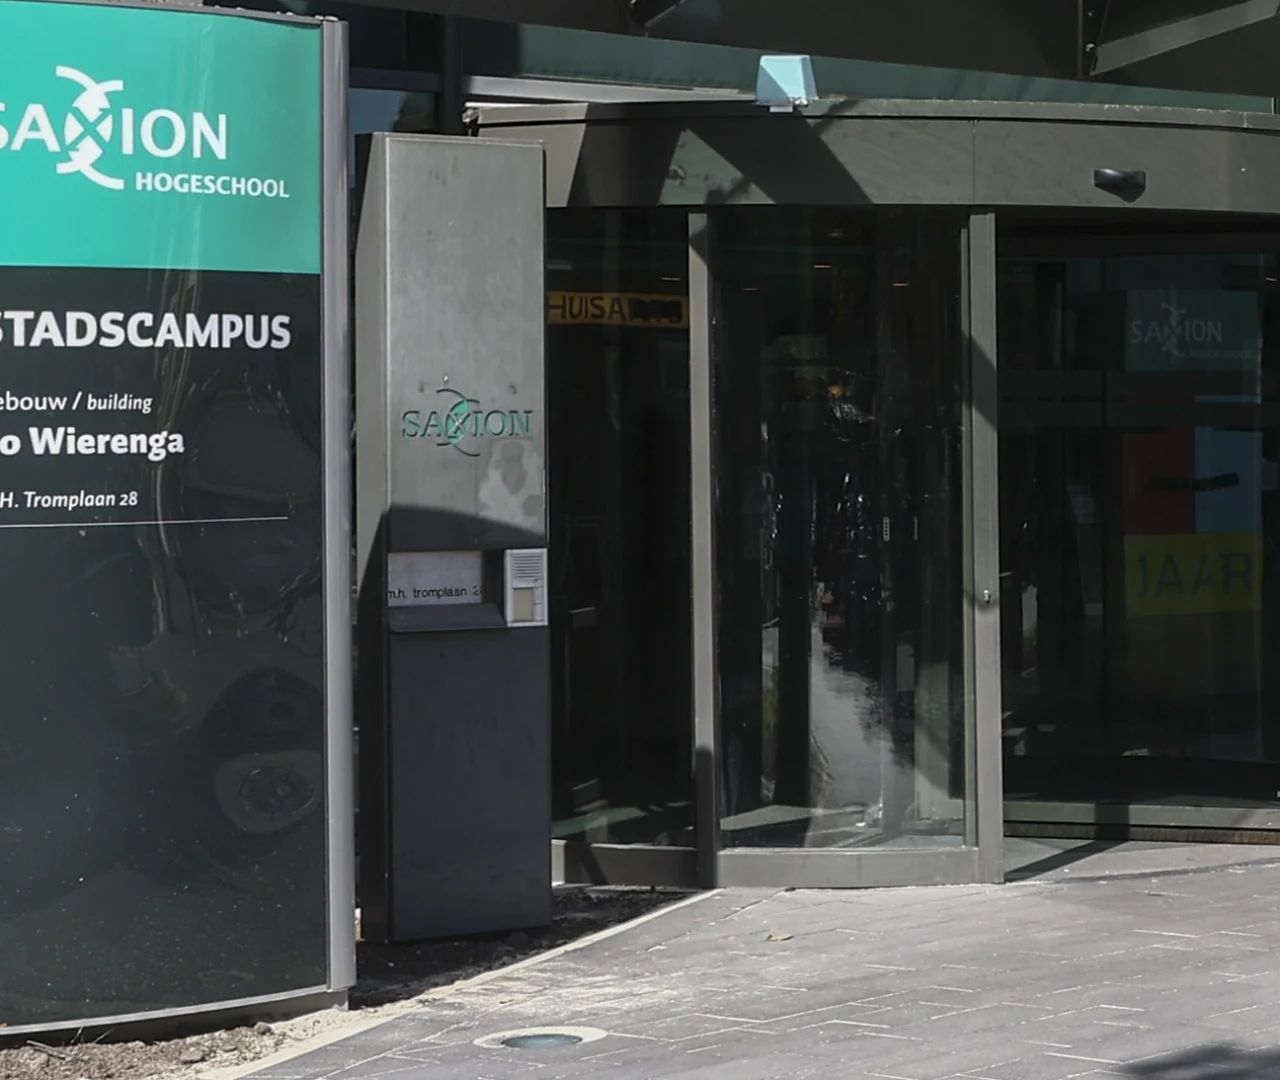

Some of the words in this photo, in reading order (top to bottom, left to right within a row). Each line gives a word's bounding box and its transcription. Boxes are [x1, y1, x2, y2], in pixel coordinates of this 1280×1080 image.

[135, 172, 290, 198] HOGESCHOOL
[0, 311, 291, 349] TADSCAMPUS
[1130, 310, 1222, 351] SAXION
[87, 393, 153, 414] building
[402, 400, 534, 444] SAXION
[28, 426, 184, 461] Wierenga
[24, 490, 116, 511] Tromplaan
[119, 491, 138, 507] 28
[413, 586, 467, 599] tromplaan
